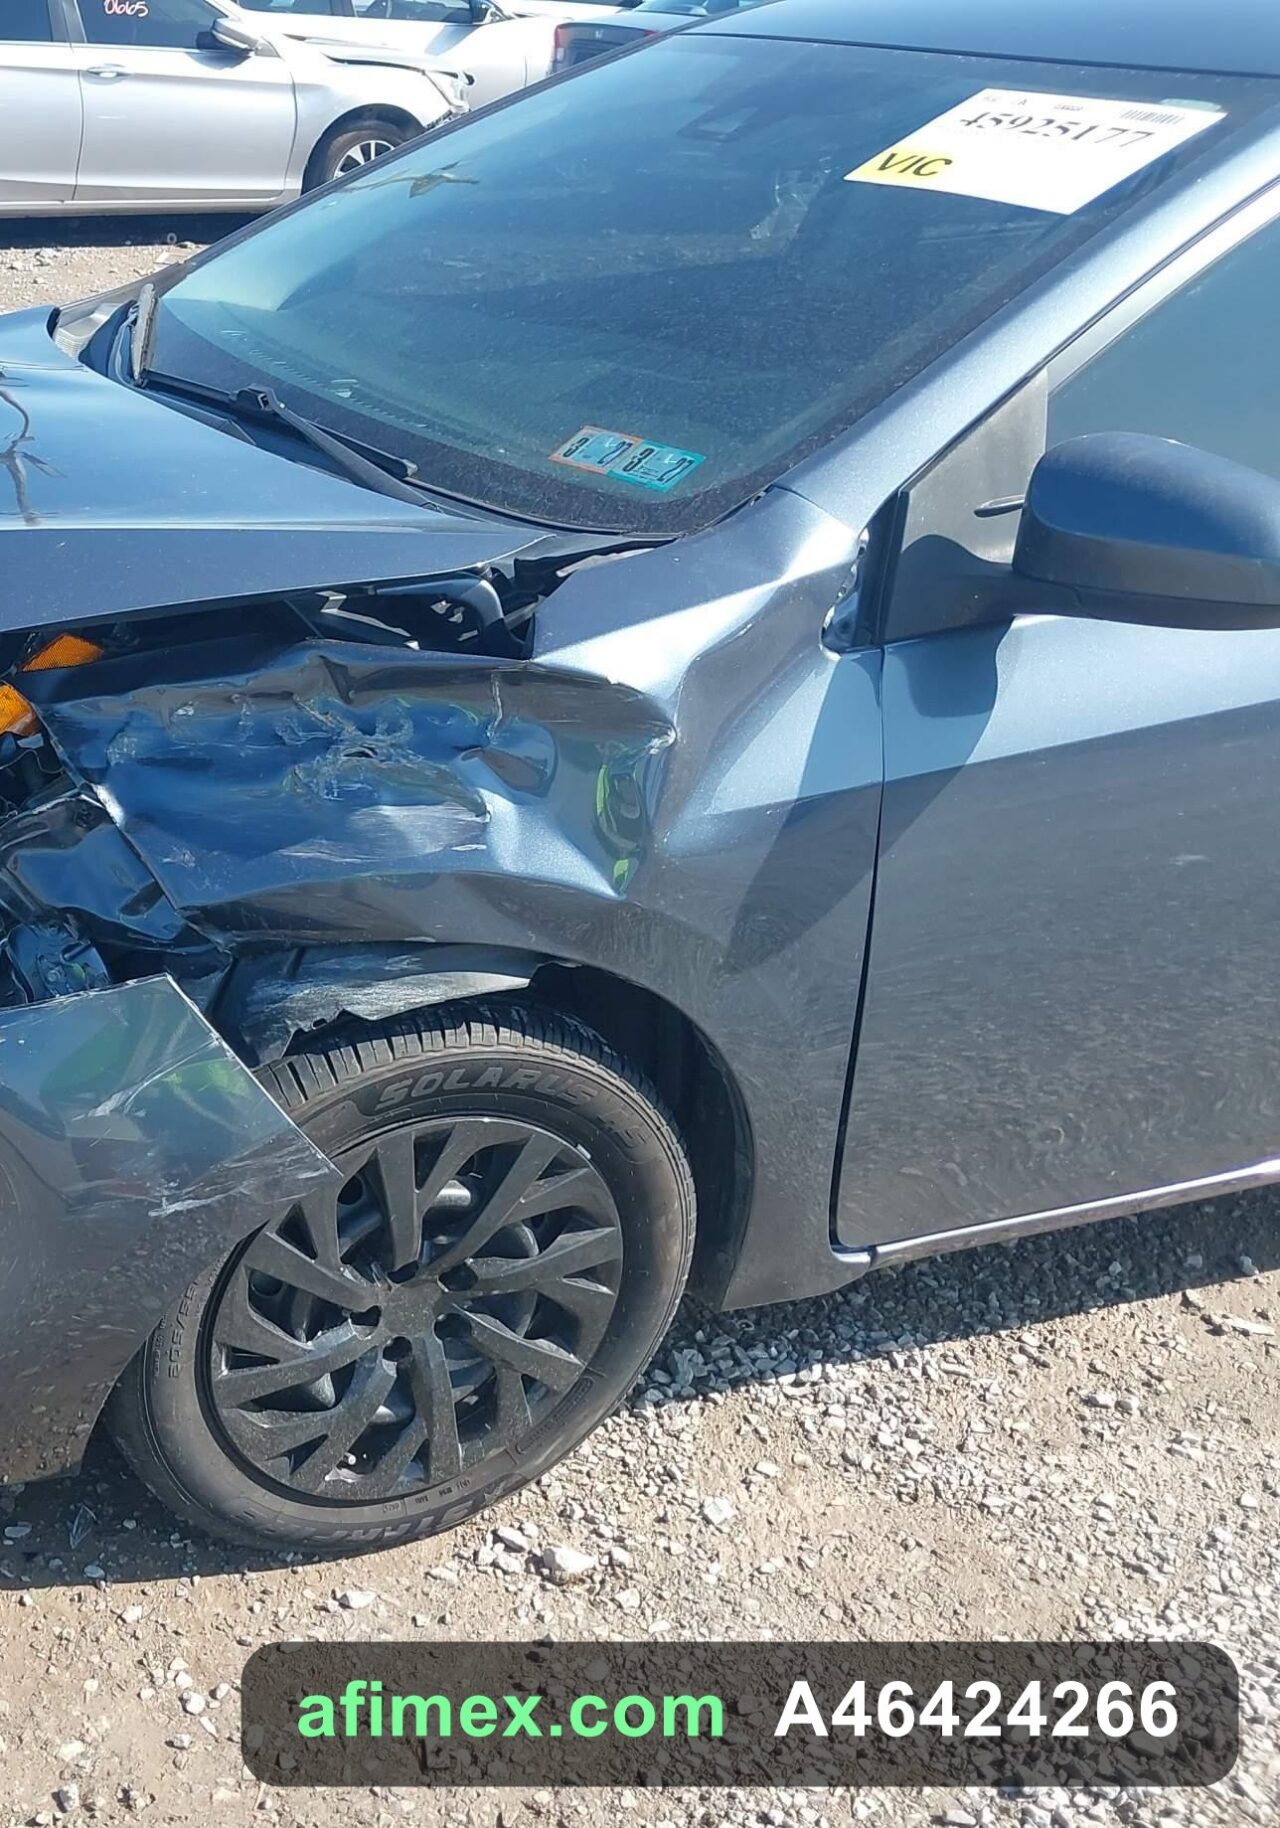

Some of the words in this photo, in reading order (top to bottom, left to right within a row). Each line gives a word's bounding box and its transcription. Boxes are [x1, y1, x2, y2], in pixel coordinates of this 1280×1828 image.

[959, 111, 1155, 147] 45925177
[877, 153, 952, 176] VIC
[622, 447, 656, 472] 3
[374, 1066, 598, 1111] SOLARUS
